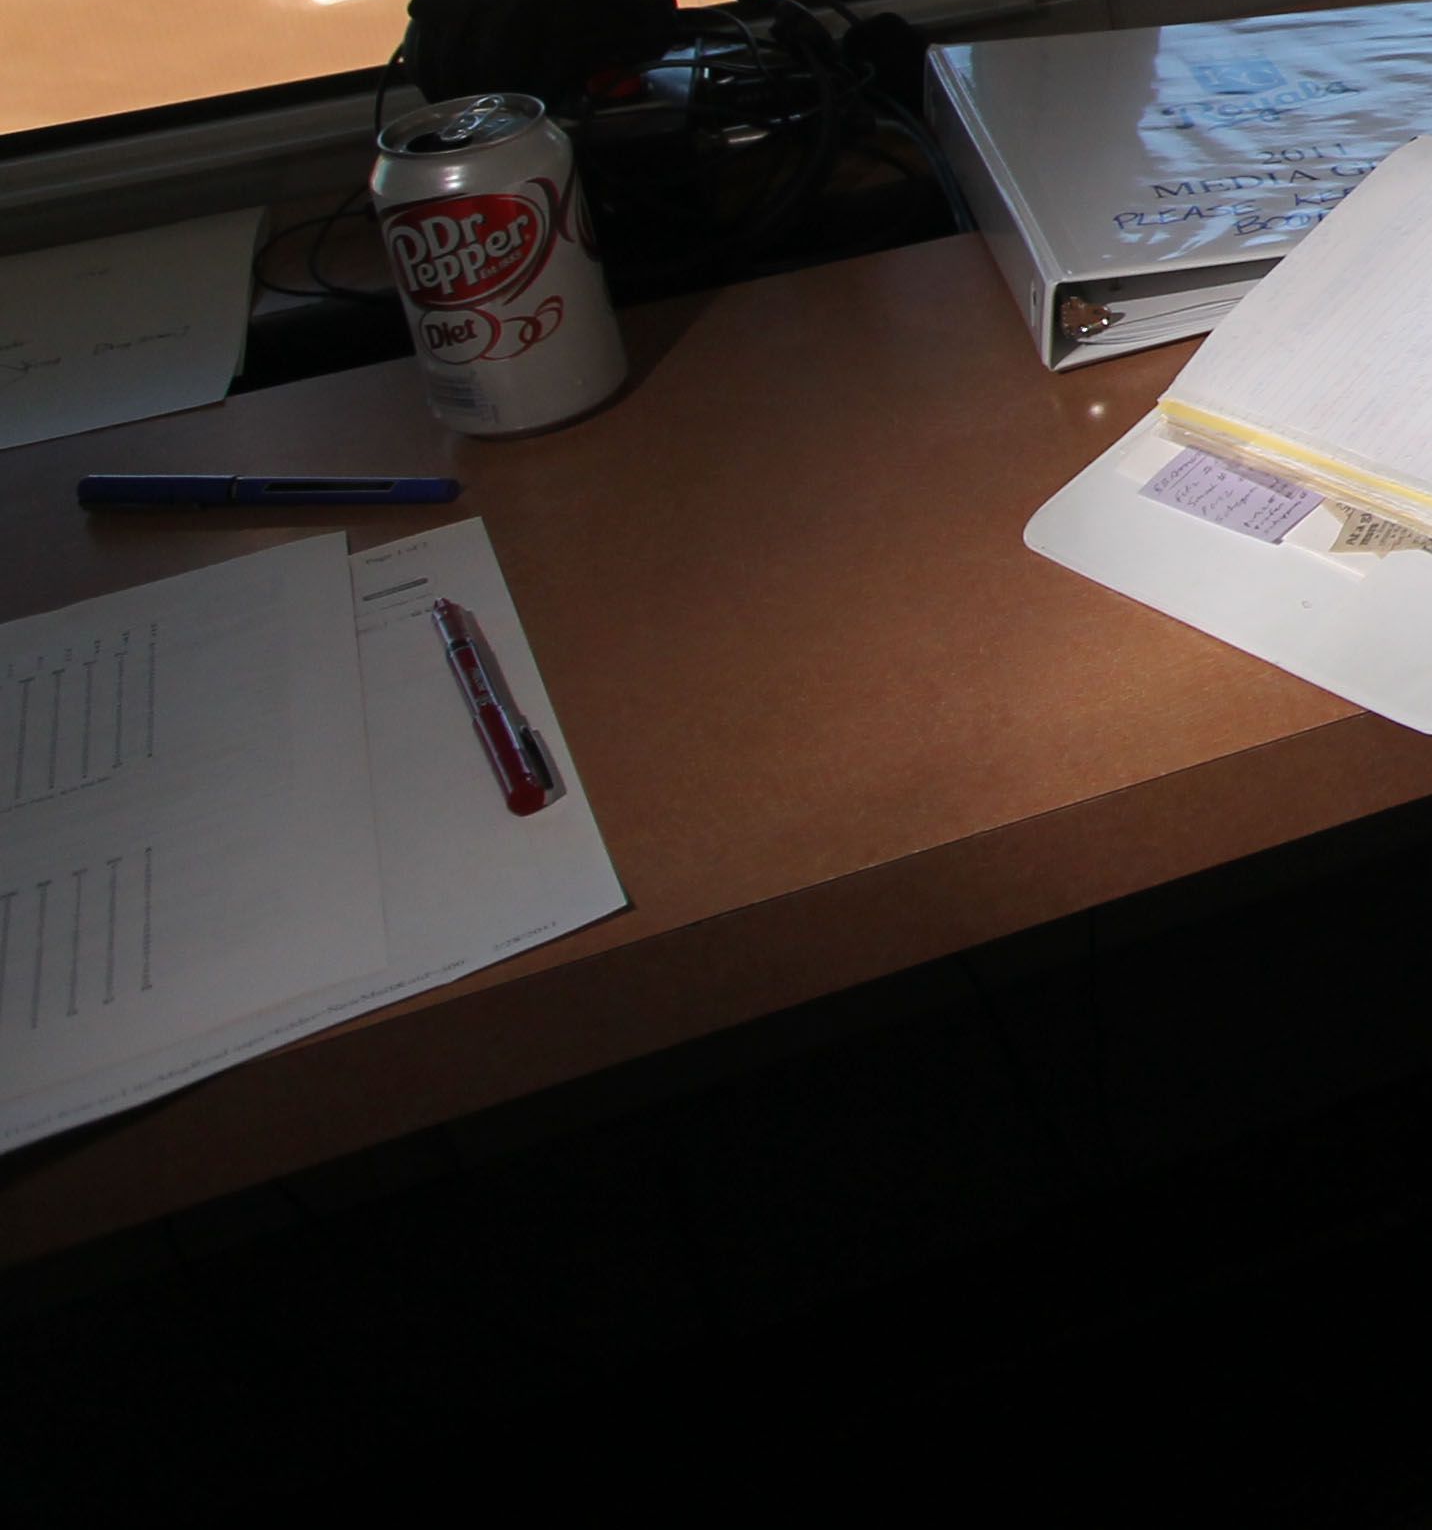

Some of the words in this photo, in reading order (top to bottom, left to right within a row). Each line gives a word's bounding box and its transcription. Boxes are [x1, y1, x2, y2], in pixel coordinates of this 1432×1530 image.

[1257, 142, 1348, 166] 2011
[1151, 168, 1321, 200] MEDIA
[1112, 198, 1264, 231] PLEASE
[421, 213, 485, 259] Dr
[388, 214, 530, 296] Pepper
[423, 318, 479, 350] Diet
